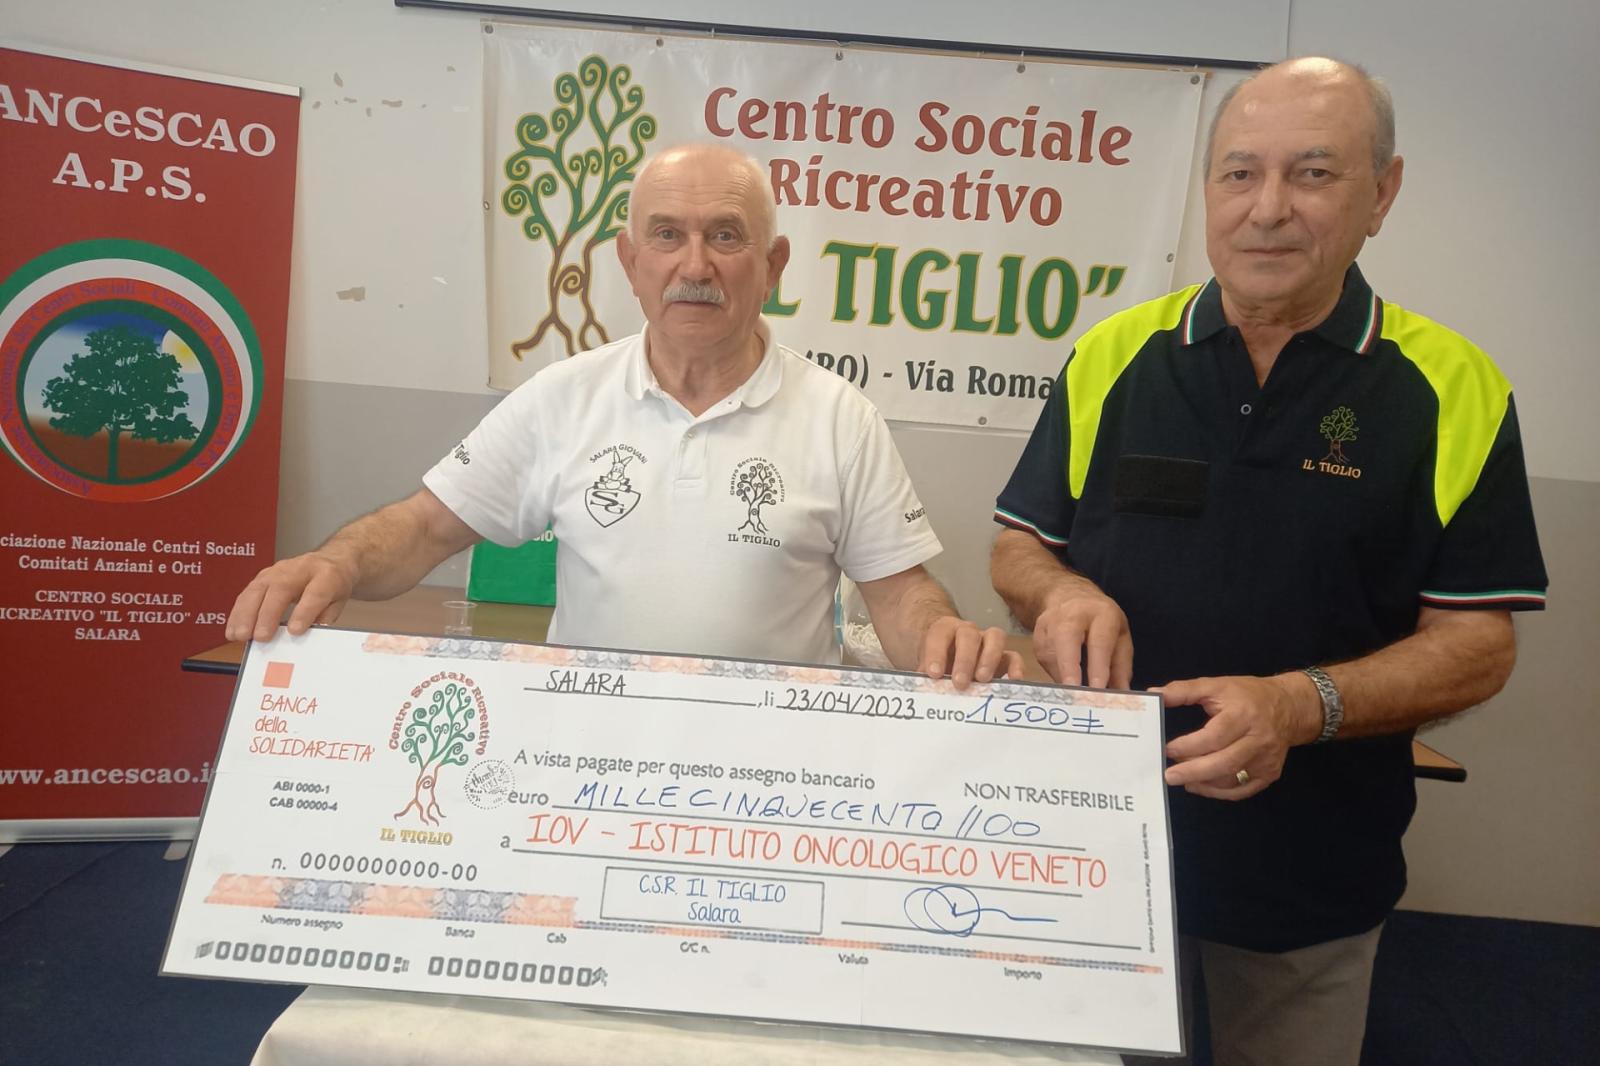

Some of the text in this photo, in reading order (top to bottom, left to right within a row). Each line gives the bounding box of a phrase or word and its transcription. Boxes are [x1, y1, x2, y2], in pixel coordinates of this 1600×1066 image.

[0, 83, 276, 157] ANCeSCAO
[704, 86, 1133, 166] Centro Sociale
[52, 152, 207, 203] A.P.S.
[768, 154, 1063, 226] Ricreativo
[905, 360, 954, 393] Via
[967, 365, 1055, 400] Roma
[589, 445, 617, 463] SALARA
[1303, 459, 1361, 478] IL TIGLIO
[0, 534, 255, 557] ciazione Nazionale Centri Sociali
[742, 534, 781, 548] TIGLIO
[19, 555, 202, 575] Comitati Anziani e Orti
[35, 590, 184, 606] CENTRO SOCIALE
[195, 612, 226, 625] APS
[74, 628, 141, 641] SALARA
[260, 694, 319, 716] BANCA
[546, 669, 627, 697] SALARA
[784, 688, 917, 720] 23/04/2023
[926, 706, 966, 722] euro
[388, 671, 491, 756] Centro Sociale Ricreativo
[255, 717, 289, 735] della
[0, 762, 214, 785] ww.ancescao.i
[514, 749, 876, 789] A vista pagate per questo assegno bancario
[273, 781, 330, 794] ABI 0000-1
[508, 790, 549, 806] euro
[964, 782, 1135, 812] NON TRASFERIBILE
[269, 797, 294, 808] CAB
[380, 827, 453, 846] IL TIGLIO
[500, 835, 510, 849] a
[526, 813, 589, 845] IOV
[628, 821, 782, 861] ISTITUTO
[793, 832, 978, 877] ONCOLOGICO
[990, 849, 1107, 889] VENETO
[271, 857, 287, 871] n.
[686, 878, 708, 897] IL
[717, 879, 786, 903] TIGLIO
[687, 901, 742, 924] Salara
[261, 914, 302, 928] Numero
[303, 918, 344, 932] assegno
[445, 926, 476, 939] Banca
[546, 932, 567, 944] Cab
[838, 953, 869, 966] Valuta
[1003, 966, 1042, 981] Importo
